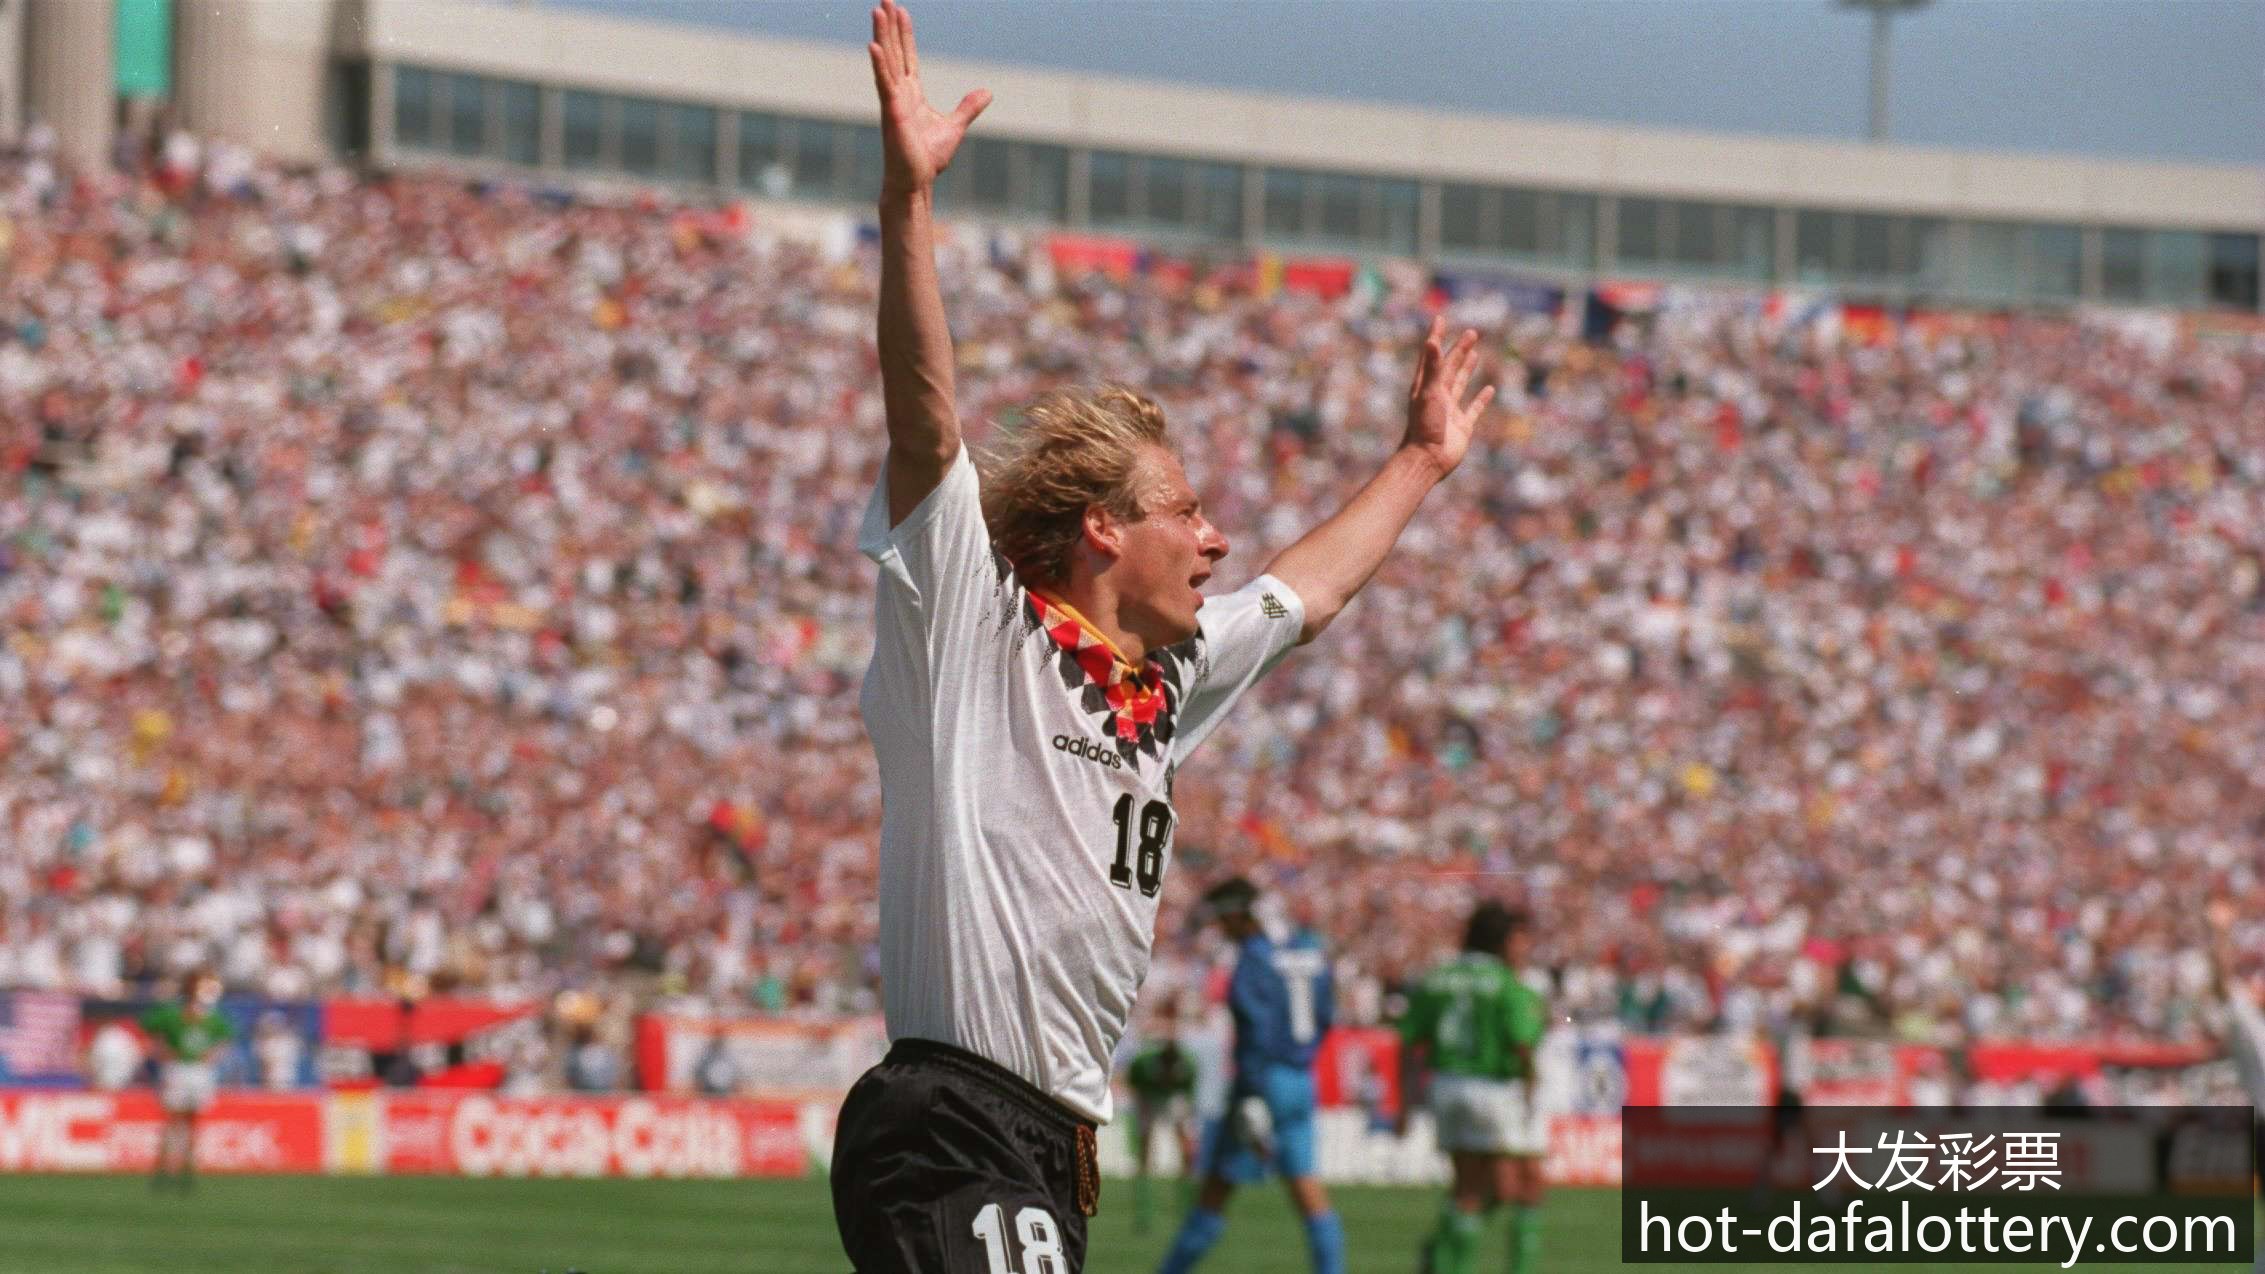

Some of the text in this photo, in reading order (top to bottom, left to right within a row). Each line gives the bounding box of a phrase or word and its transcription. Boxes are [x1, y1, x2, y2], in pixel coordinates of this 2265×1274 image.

[1052, 734, 1122, 770] adidas
[1110, 793, 1173, 898] 18
[971, 1203, 1070, 1274] 18
